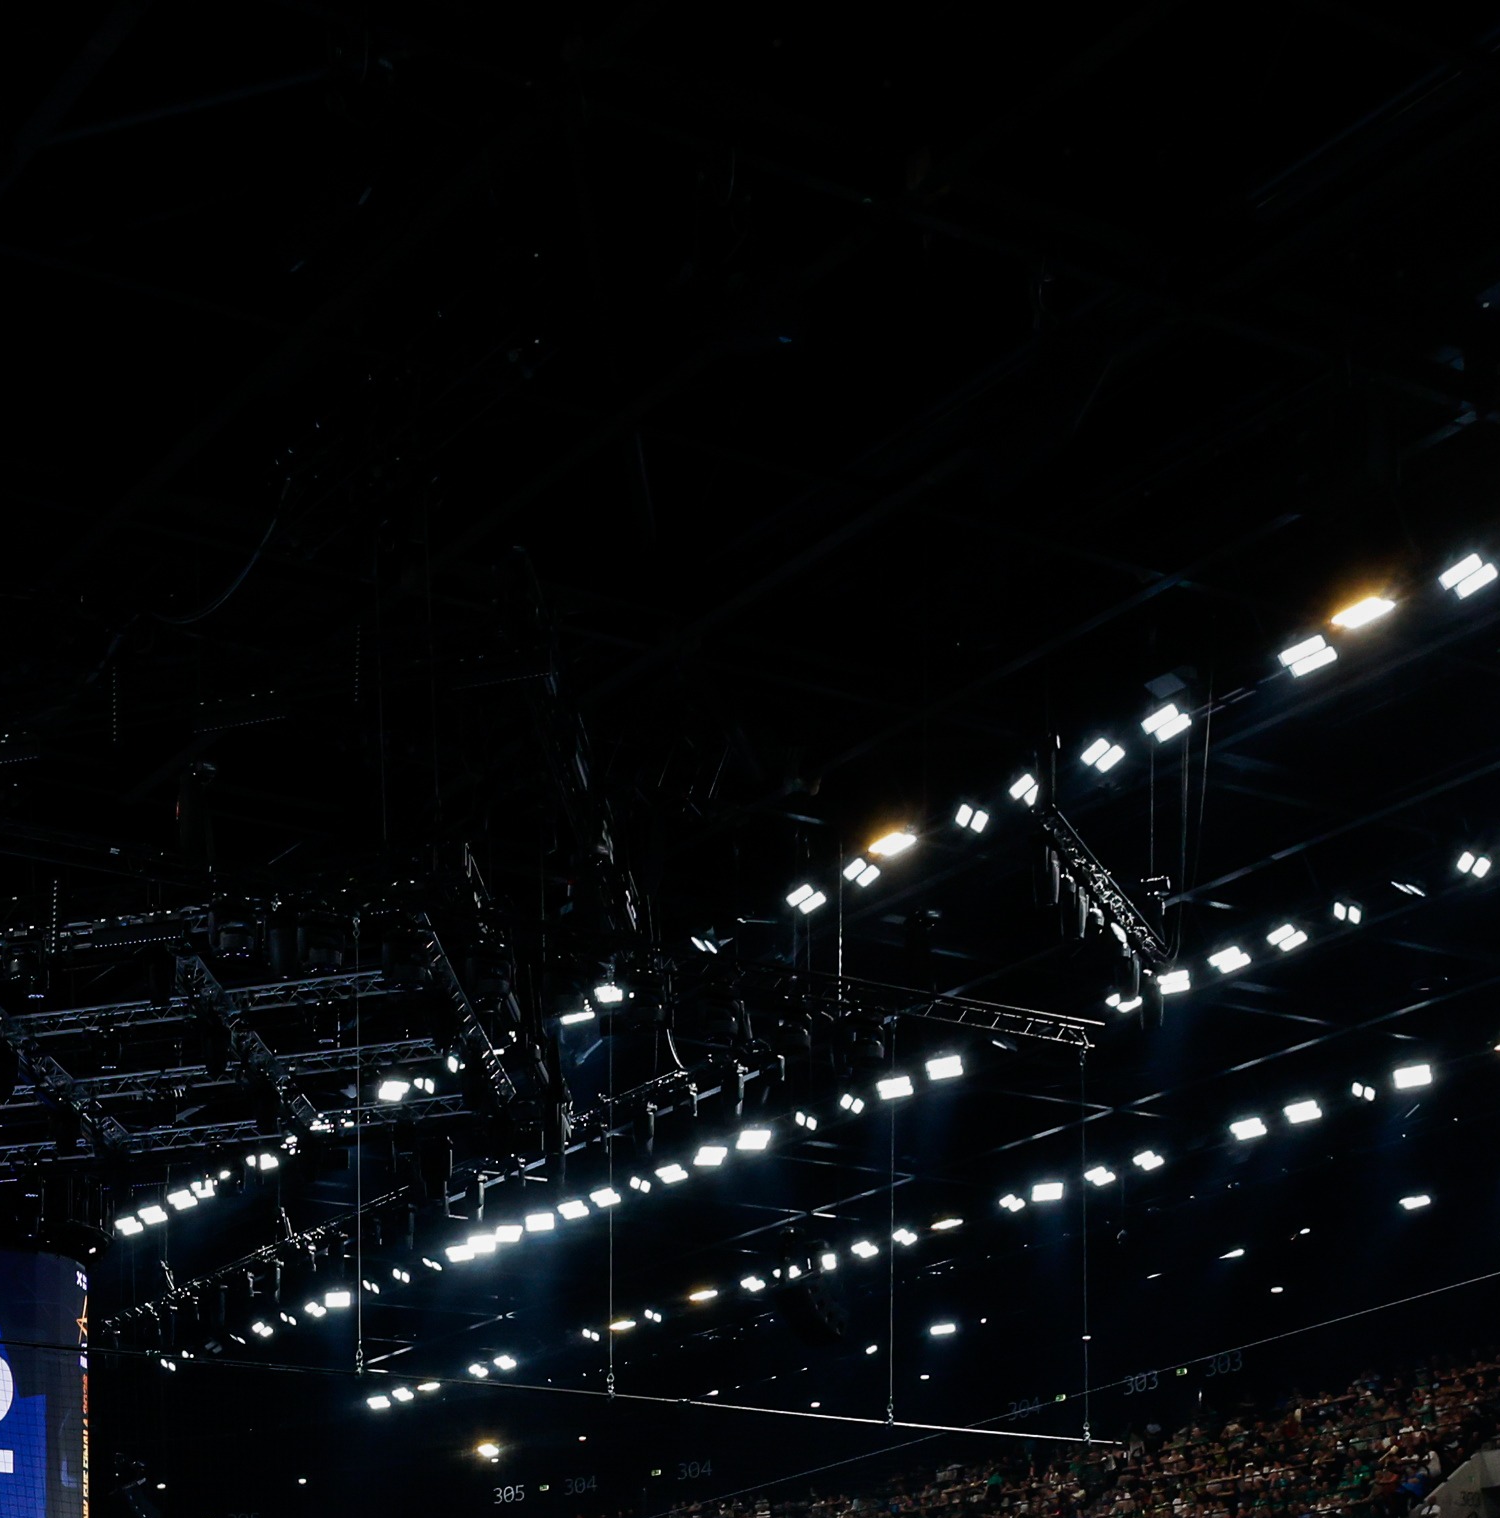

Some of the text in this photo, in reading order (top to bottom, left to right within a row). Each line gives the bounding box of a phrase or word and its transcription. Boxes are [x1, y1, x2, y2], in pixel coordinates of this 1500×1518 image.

[1204, 1349, 1243, 1377] 303
[1123, 1369, 1160, 1396] 303
[677, 1461, 713, 1481] 304
[493, 1484, 526, 1504] 305
[564, 1476, 598, 1496] 304
